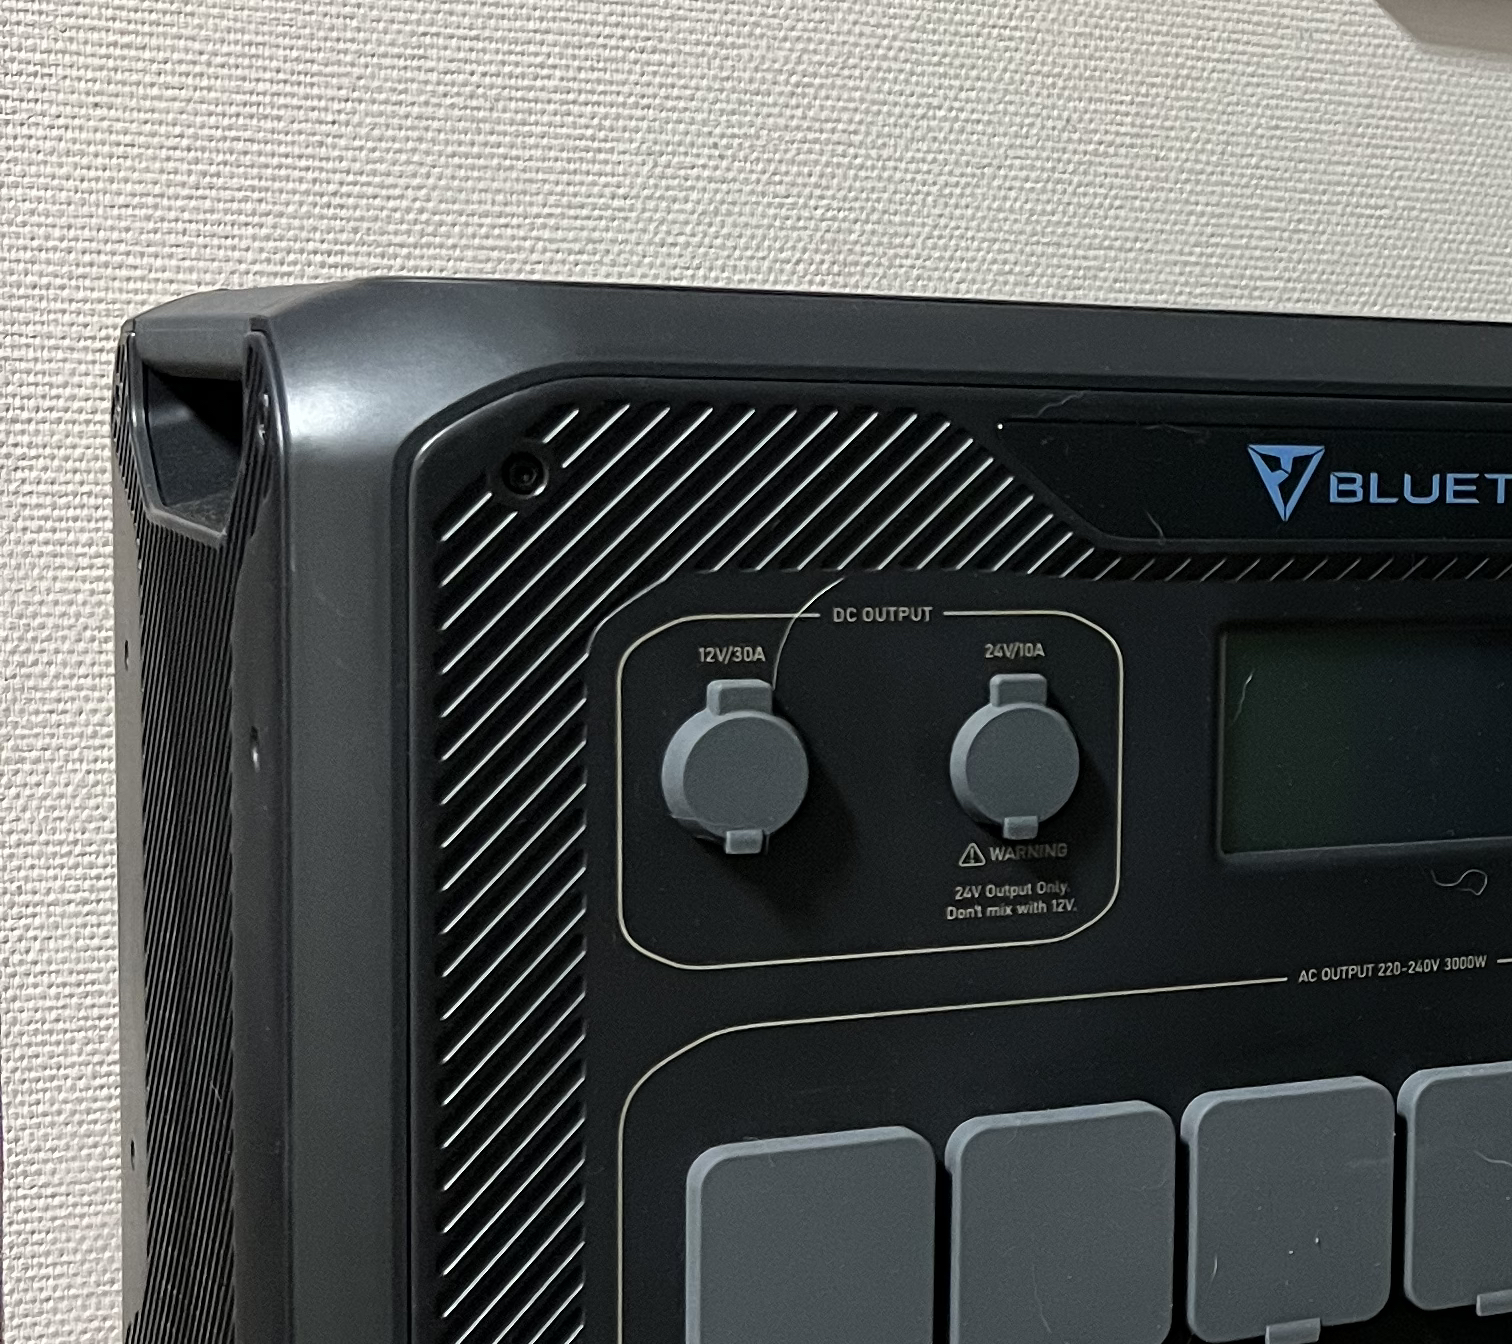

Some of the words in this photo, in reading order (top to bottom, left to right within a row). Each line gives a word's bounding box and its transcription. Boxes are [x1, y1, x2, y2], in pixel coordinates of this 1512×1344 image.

[832, 608, 858, 623] DC
[863, 606, 933, 622] OUTPUT
[698, 646, 766, 663] 12V/30A
[984, 642, 1045, 659] 24V/10A
[989, 843, 1068, 861] WARNING
[955, 885, 982, 900] 24V
[985, 883, 1032, 899] Output
[946, 904, 983, 920] Don't
[986, 903, 1013, 917] mix
[1016, 900, 1047, 915] with
[1298, 969, 1318, 984] AC
[1321, 964, 1375, 982] OUTPUT
[1377, 958, 1440, 977] 220-240V
[1444, 955, 1487, 971] 3000W
